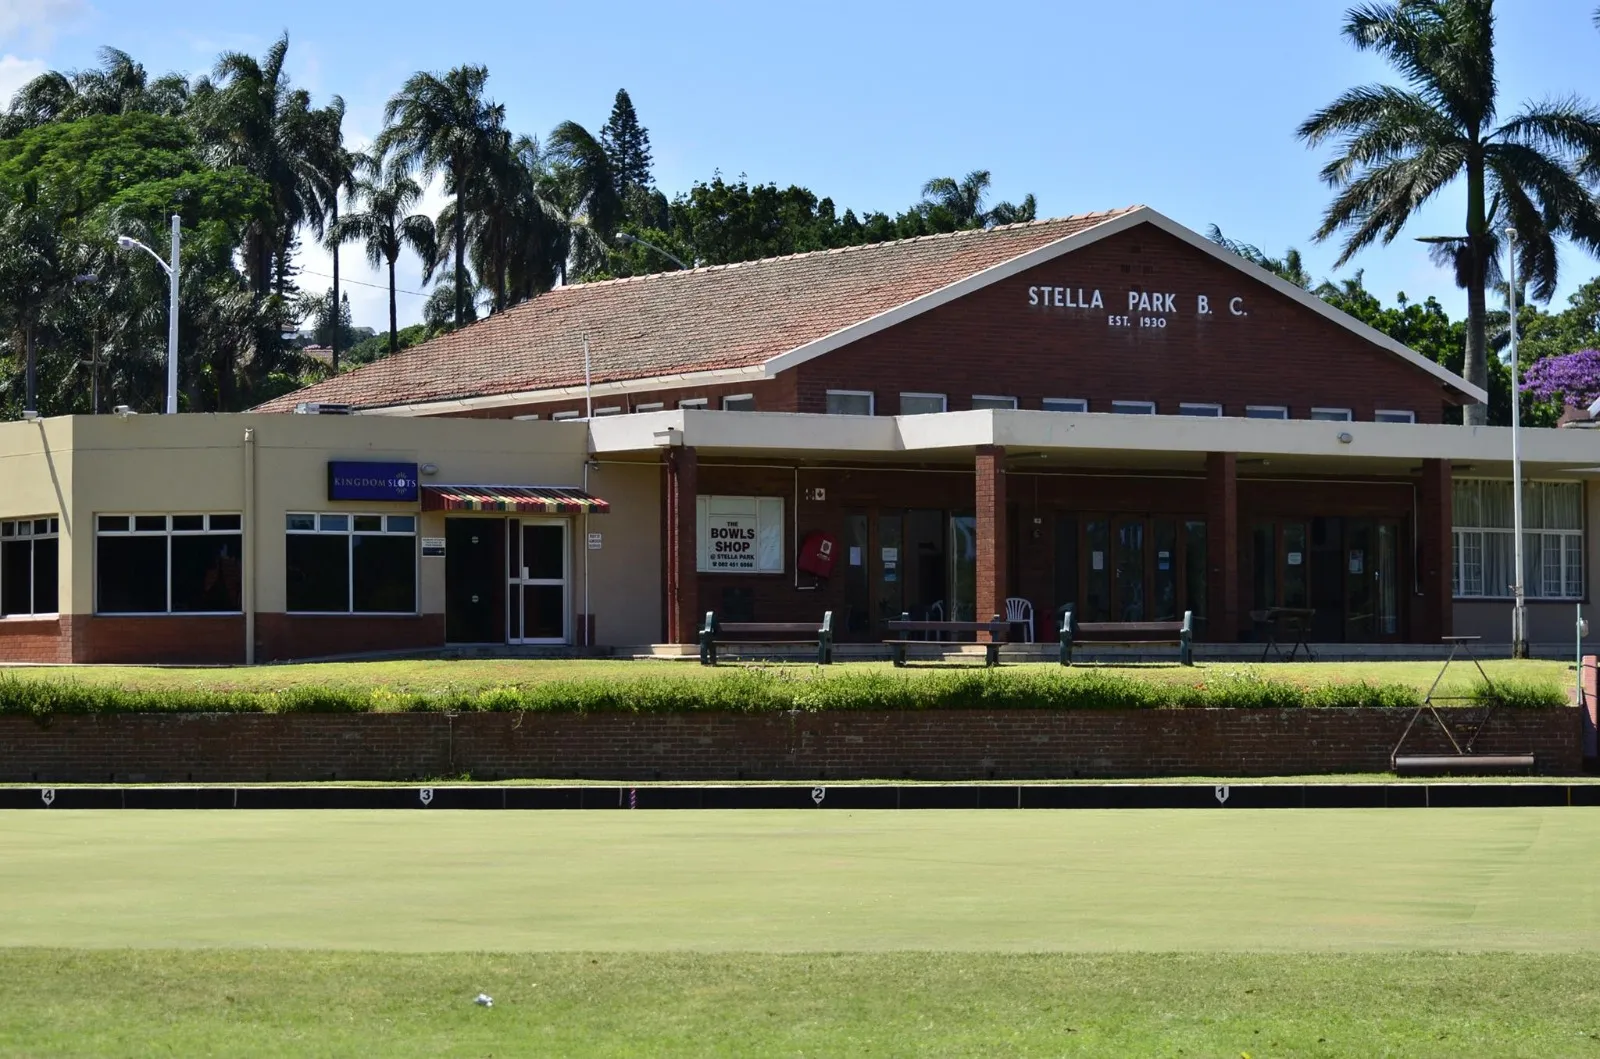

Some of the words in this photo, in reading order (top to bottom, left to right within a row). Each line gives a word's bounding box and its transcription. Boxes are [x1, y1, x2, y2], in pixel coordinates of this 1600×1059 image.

[1028, 286, 1104, 309] STELLA
[1128, 291, 1177, 313] PARK
[1197, 295, 1213, 314] B.
[1229, 297, 1248, 316] C.
[1108, 315, 1131, 327] EST.
[1140, 317, 1167, 328] 1930
[334, 478, 386, 487] KINGDOM
[387, 478, 416, 487] SLOTS
[711, 528, 755, 539] BOWLS
[715, 541, 750, 552] SHOP
[44, 789, 53, 800] 4
[422, 789, 431, 800] 3
[814, 788, 823, 799] 2
[1218, 787, 1224, 798] 1
